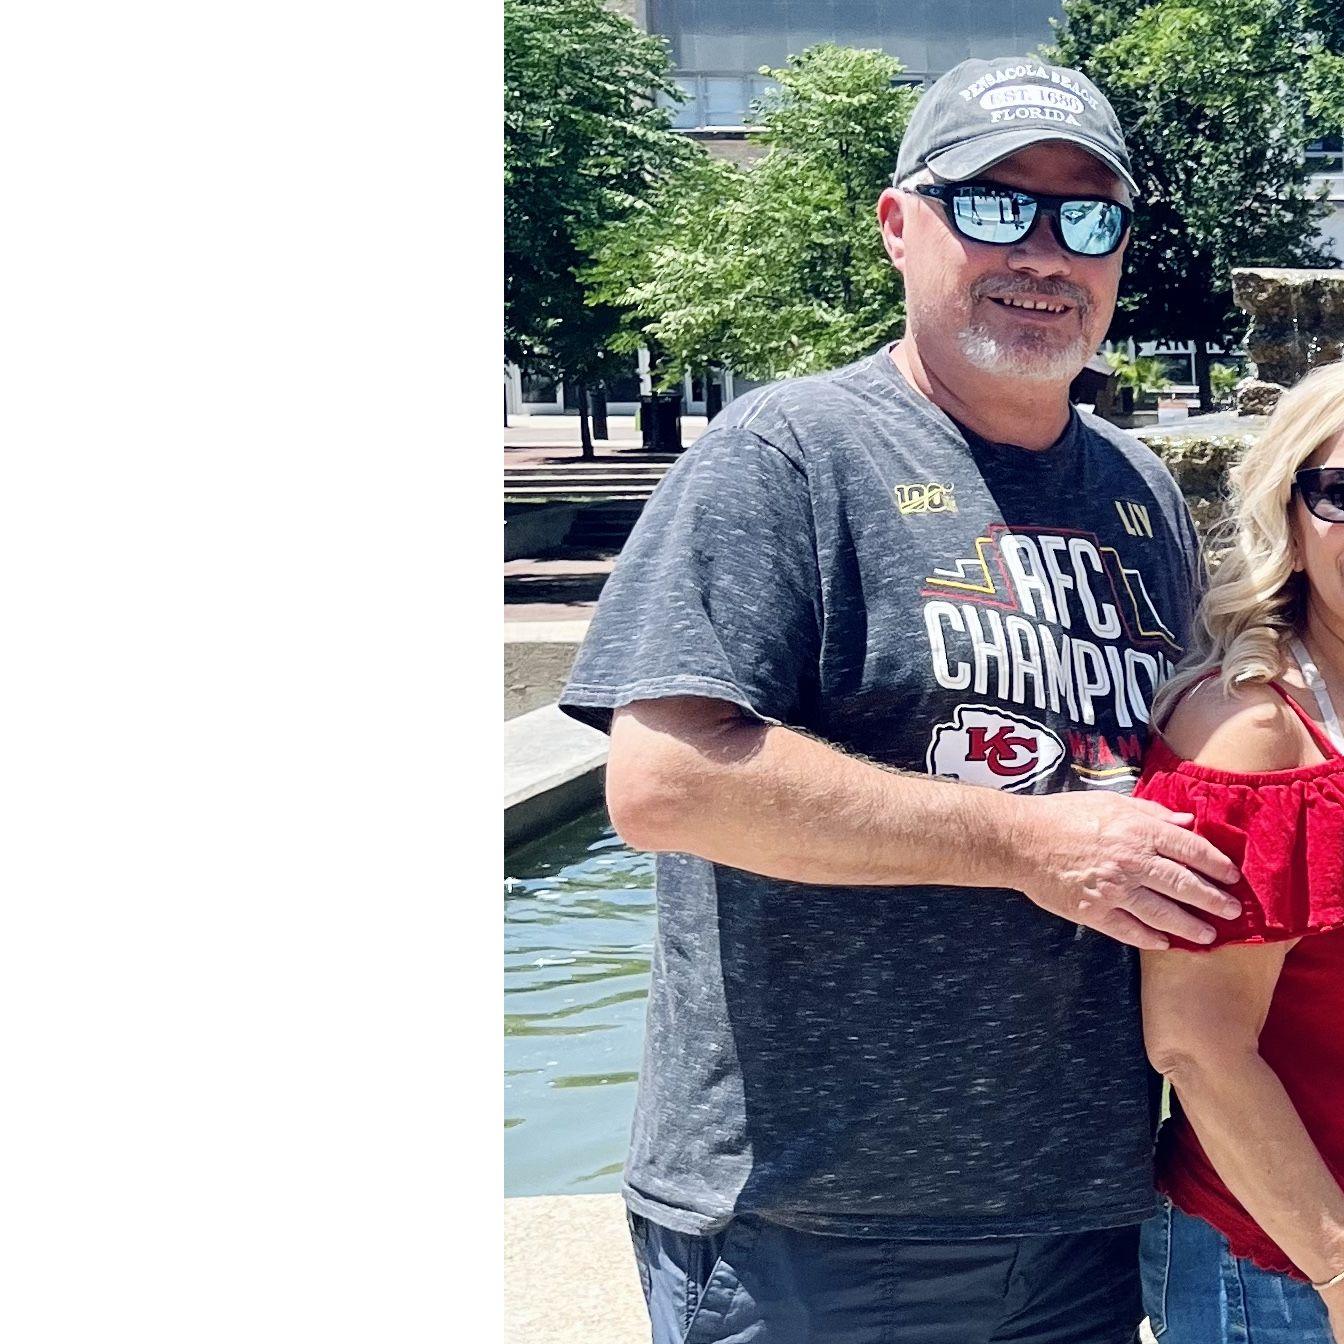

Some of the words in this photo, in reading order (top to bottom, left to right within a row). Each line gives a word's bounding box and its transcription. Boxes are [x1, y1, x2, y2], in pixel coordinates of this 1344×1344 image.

[958, 64, 1050, 102] PENSACOLA
[1050, 71, 1099, 110] BEACH
[990, 107, 1082, 127] FLORIDA
[1114, 500, 1154, 538] LIV
[999, 534, 1122, 639] AFC
[923, 601, 1176, 728] CHAMPIO
[964, 725, 1039, 777] KC
[1064, 729, 1142, 767] MIAM
